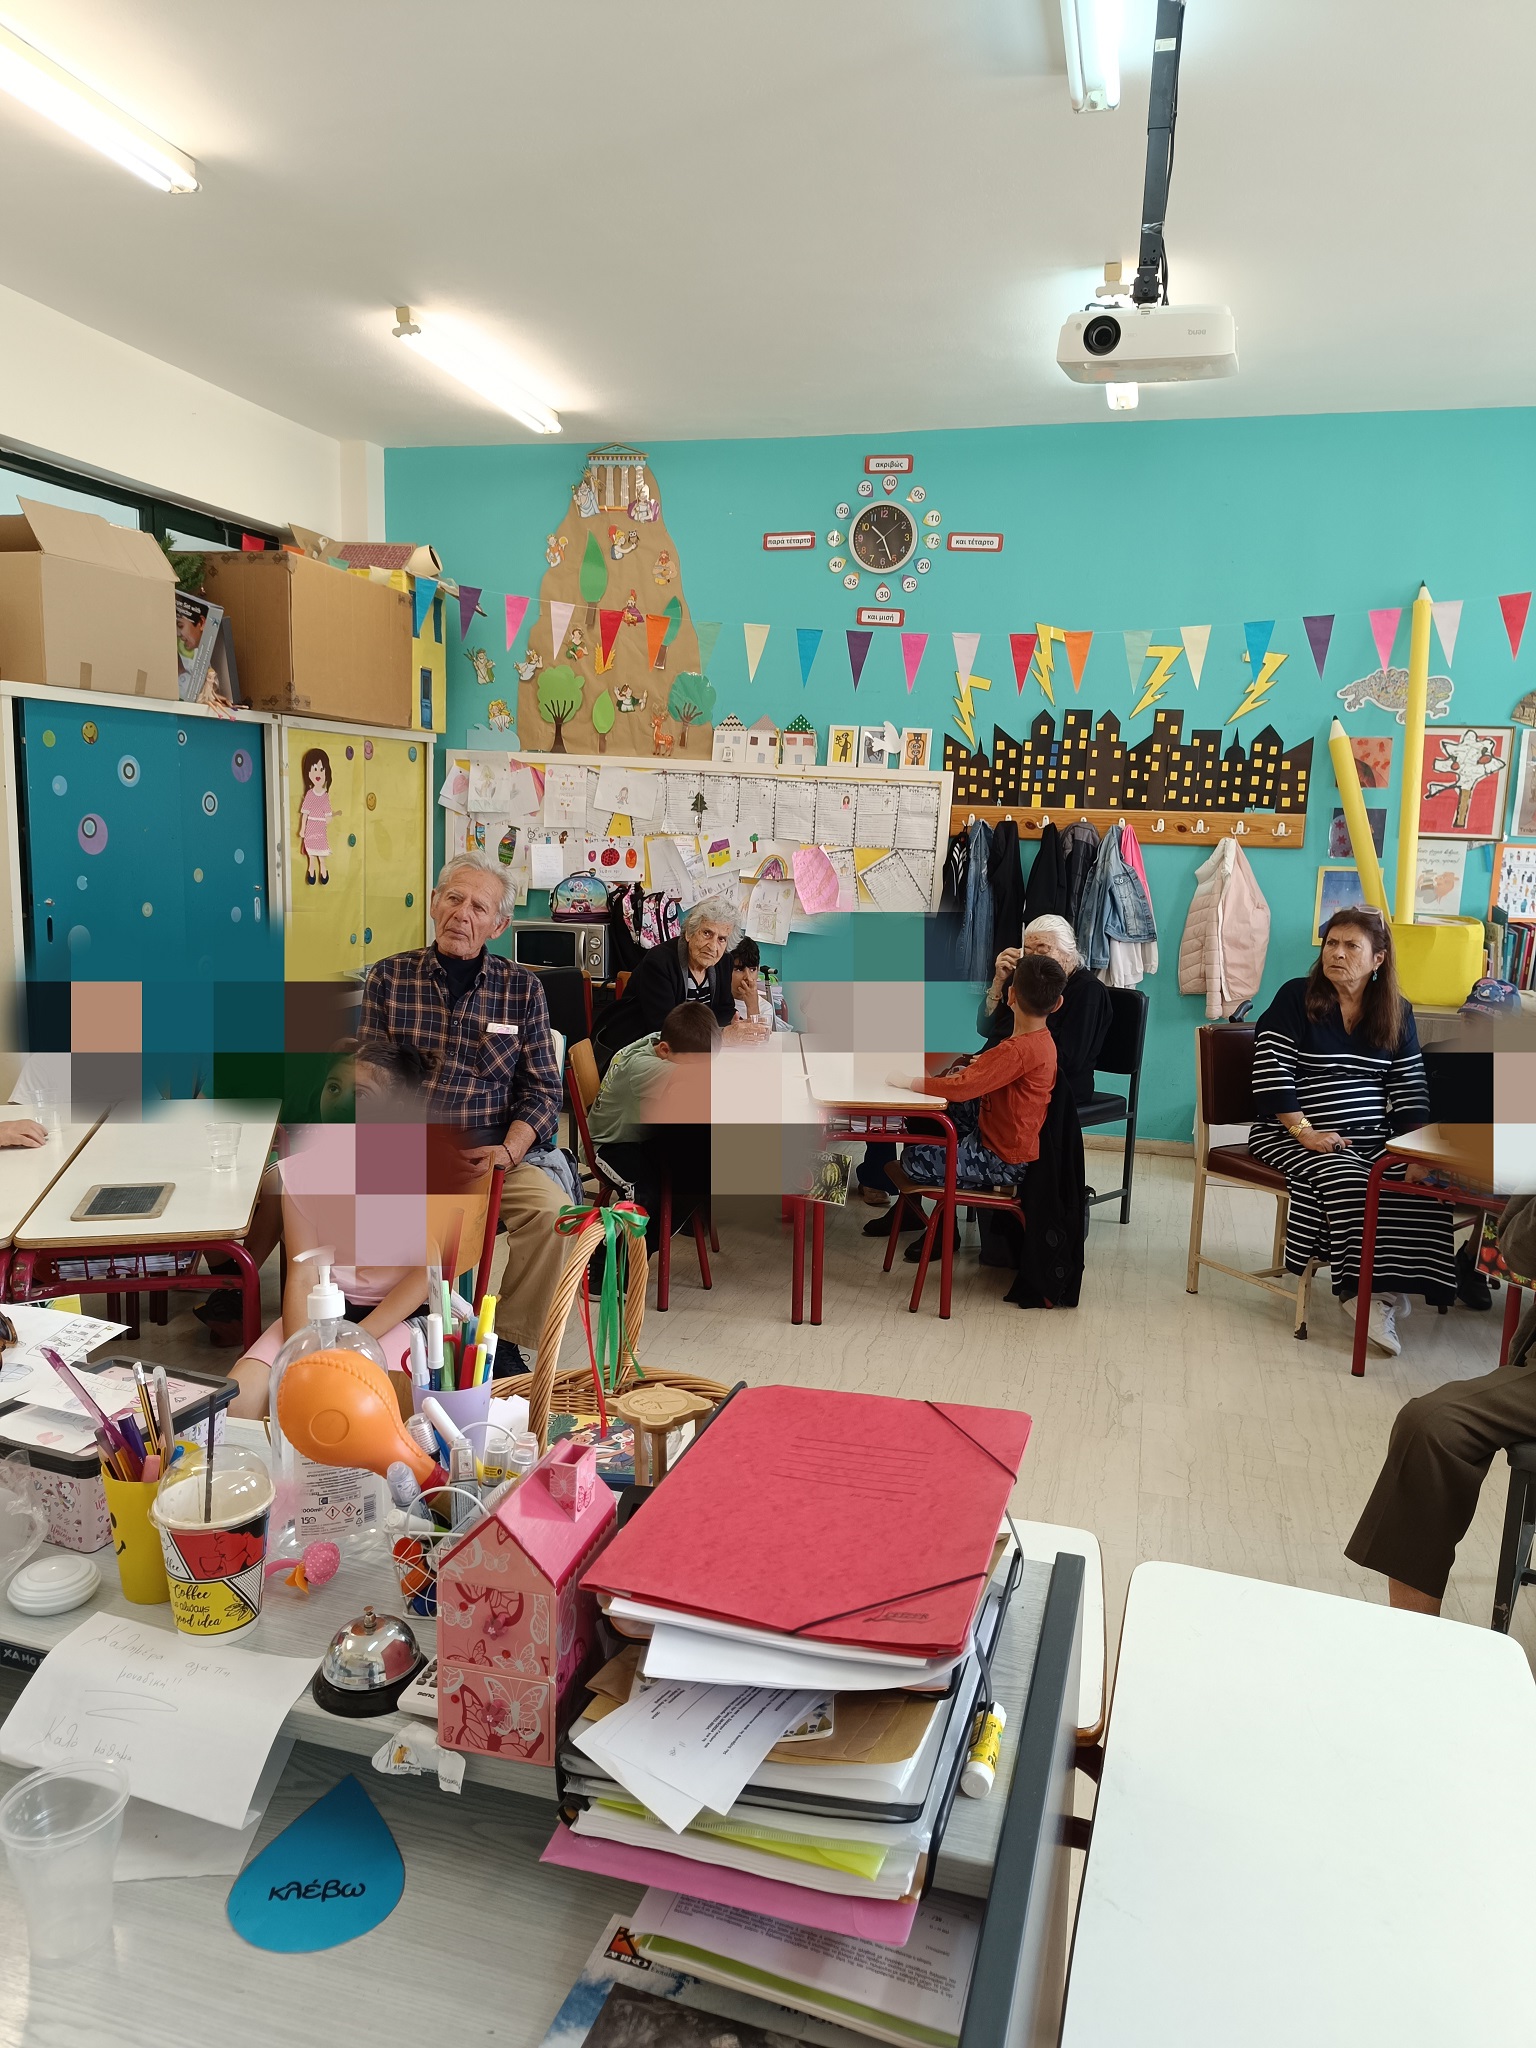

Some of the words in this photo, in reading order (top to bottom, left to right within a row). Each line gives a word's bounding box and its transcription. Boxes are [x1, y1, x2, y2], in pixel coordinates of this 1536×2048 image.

[875, 460, 904, 469] ακριβώς
[870, 513, 877, 522] 11
[880, 509, 888, 518] 12
[862, 522, 870, 531] 10
[901, 521, 907, 530] 2
[767, 537, 785, 546] παρά
[786, 536, 811, 545] τέταρτο
[858, 534, 864, 543] 9
[904, 533, 910, 542] 3
[968, 538, 995, 547] τέταρτο
[861, 546, 867, 555] 8
[900, 545, 906, 554] 4
[869, 554, 875, 563] 7
[879, 557, 886, 566] 6
[891, 554, 897, 562] 5
[879, 613, 894, 622] μισή
[173, 1584, 212, 1601] Coffee
[179, 1601, 211, 1616] always
[197, 1614, 222, 1629] idea
[81, 1624, 164, 1662] Καλημέρα
[26, 1714, 79, 1751] Καλό
[267, 1878, 367, 1903] κλέβω
